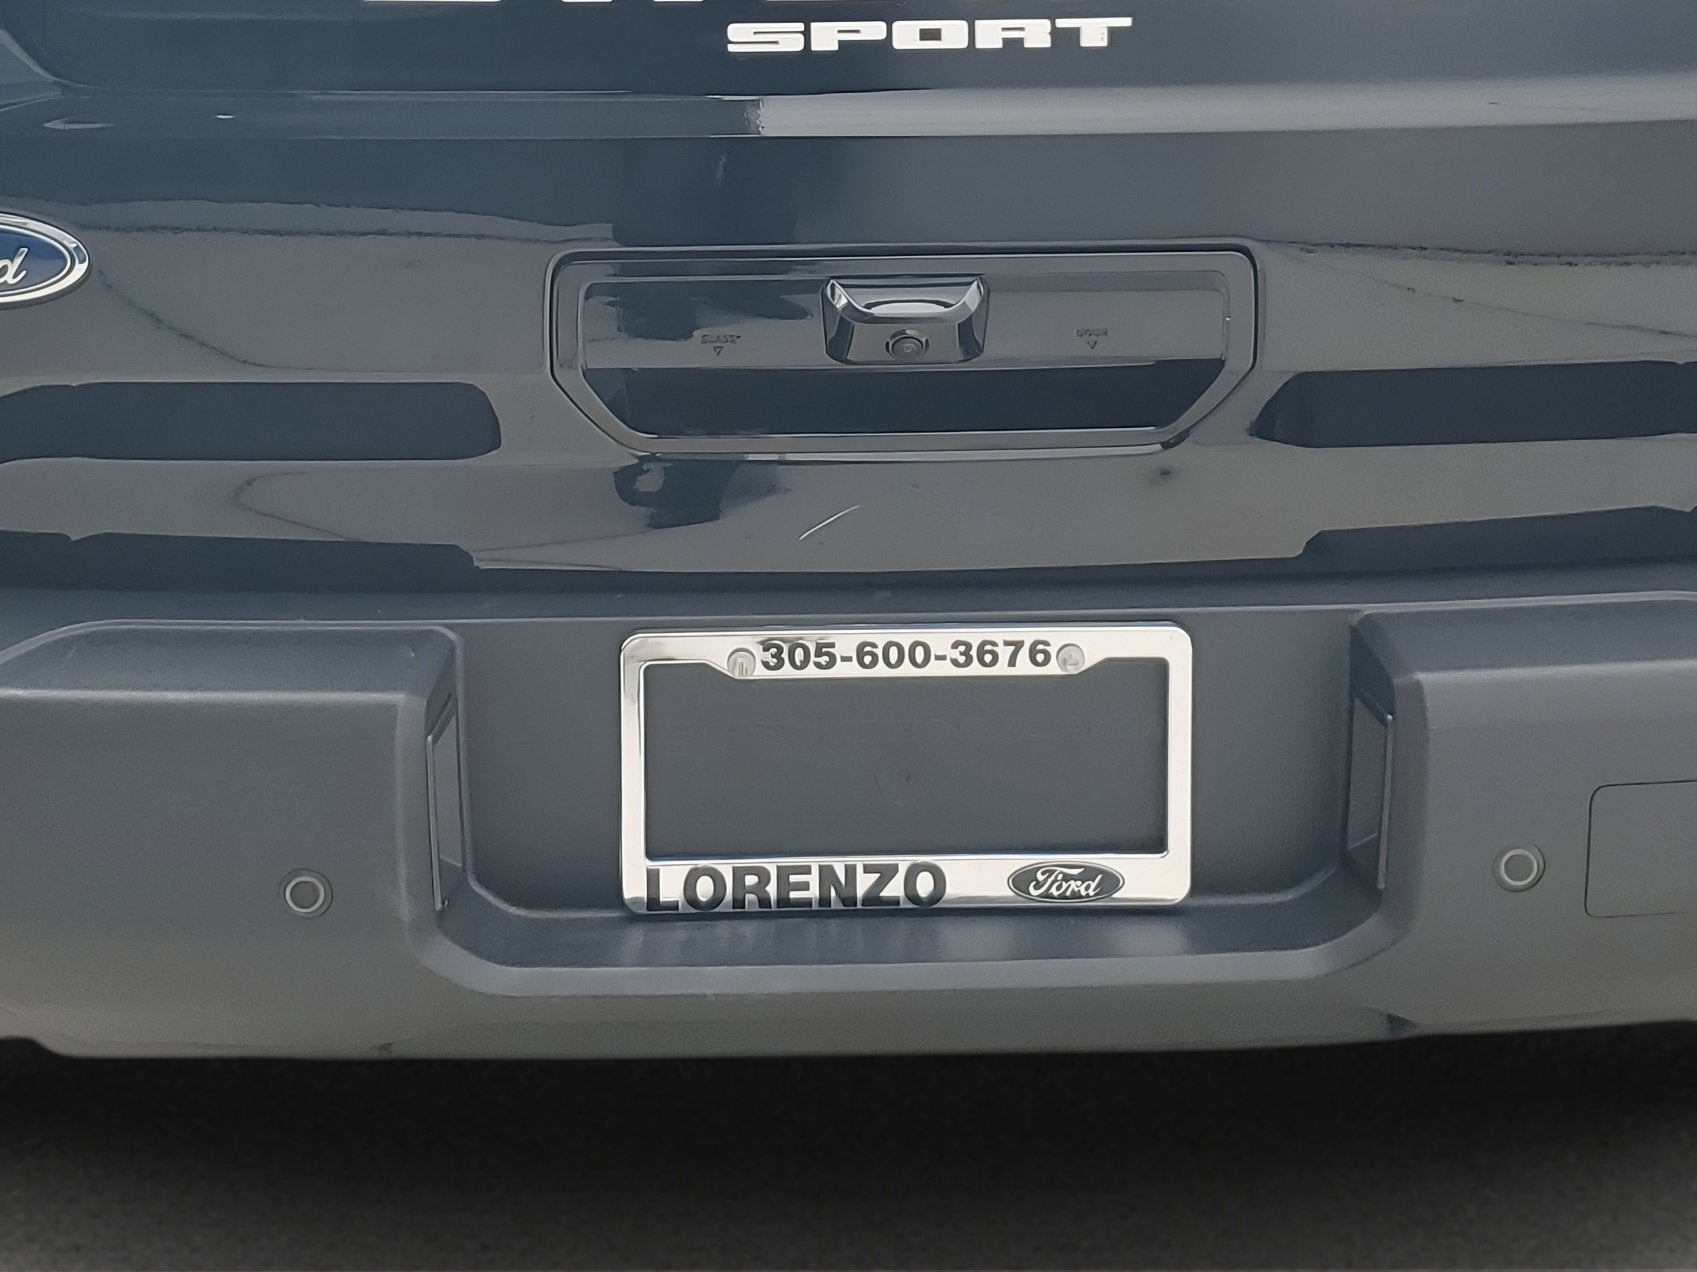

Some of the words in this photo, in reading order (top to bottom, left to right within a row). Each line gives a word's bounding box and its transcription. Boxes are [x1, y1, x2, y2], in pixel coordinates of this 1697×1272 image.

[727, 16, 1133, 53] SPORT
[760, 639, 1052, 671] 305-600-3676
[645, 862, 947, 911] LORENZO
[1028, 866, 1103, 896] Ford
